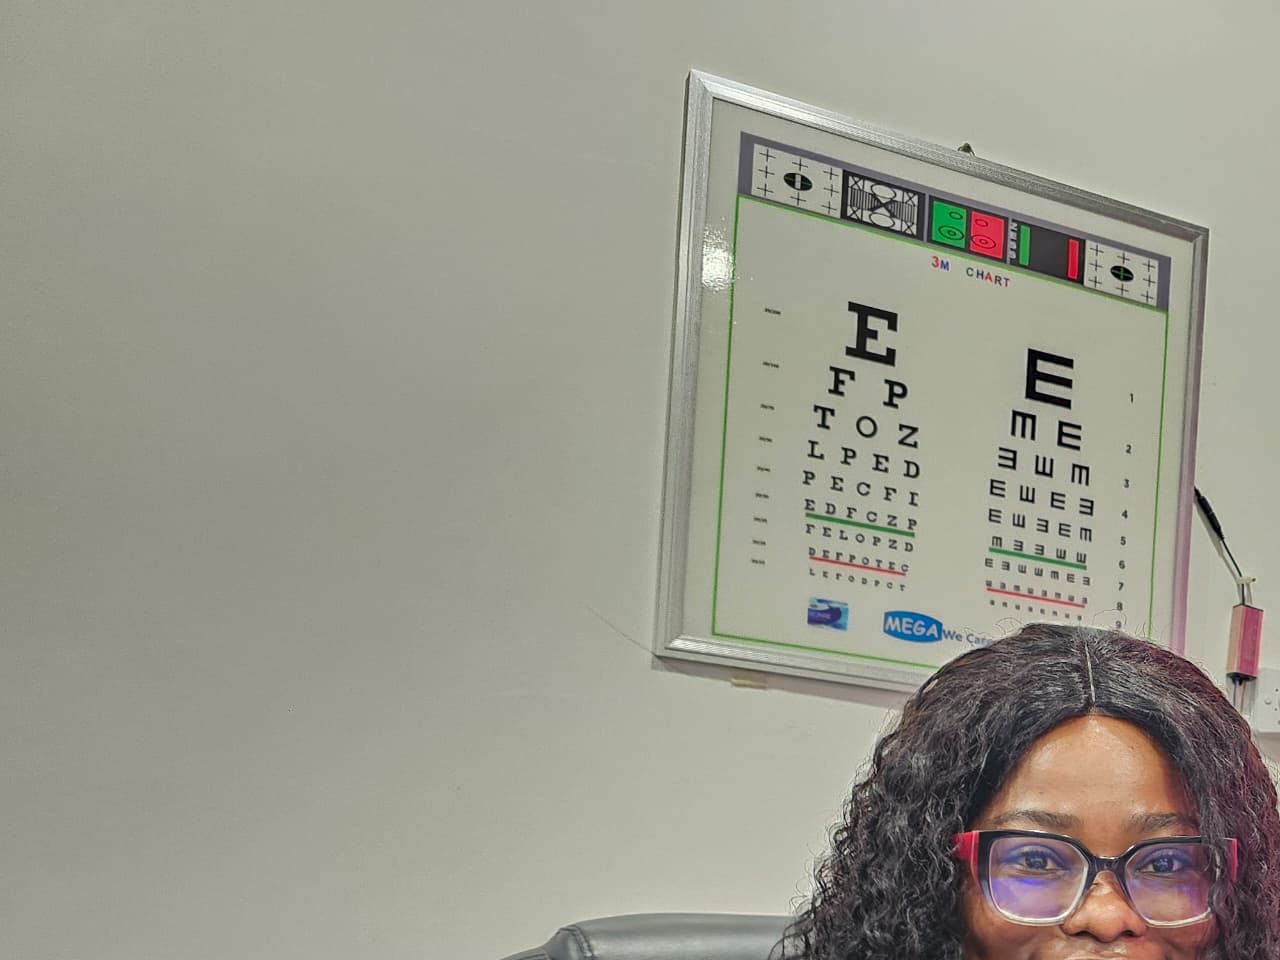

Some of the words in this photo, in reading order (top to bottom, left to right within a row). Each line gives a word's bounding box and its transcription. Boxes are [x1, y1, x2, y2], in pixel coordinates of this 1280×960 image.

[931, 255, 950, 271] 3M
[966, 267, 1011, 287] CHART
[845, 301, 898, 367] E
[1024, 347, 1074, 411] E
[1125, 444, 1132, 454] 2
[1123, 478, 1130, 488] 3
[1121, 509, 1128, 519] 4
[884, 615, 939, 638] MEGA
[942, 629, 963, 642] We
